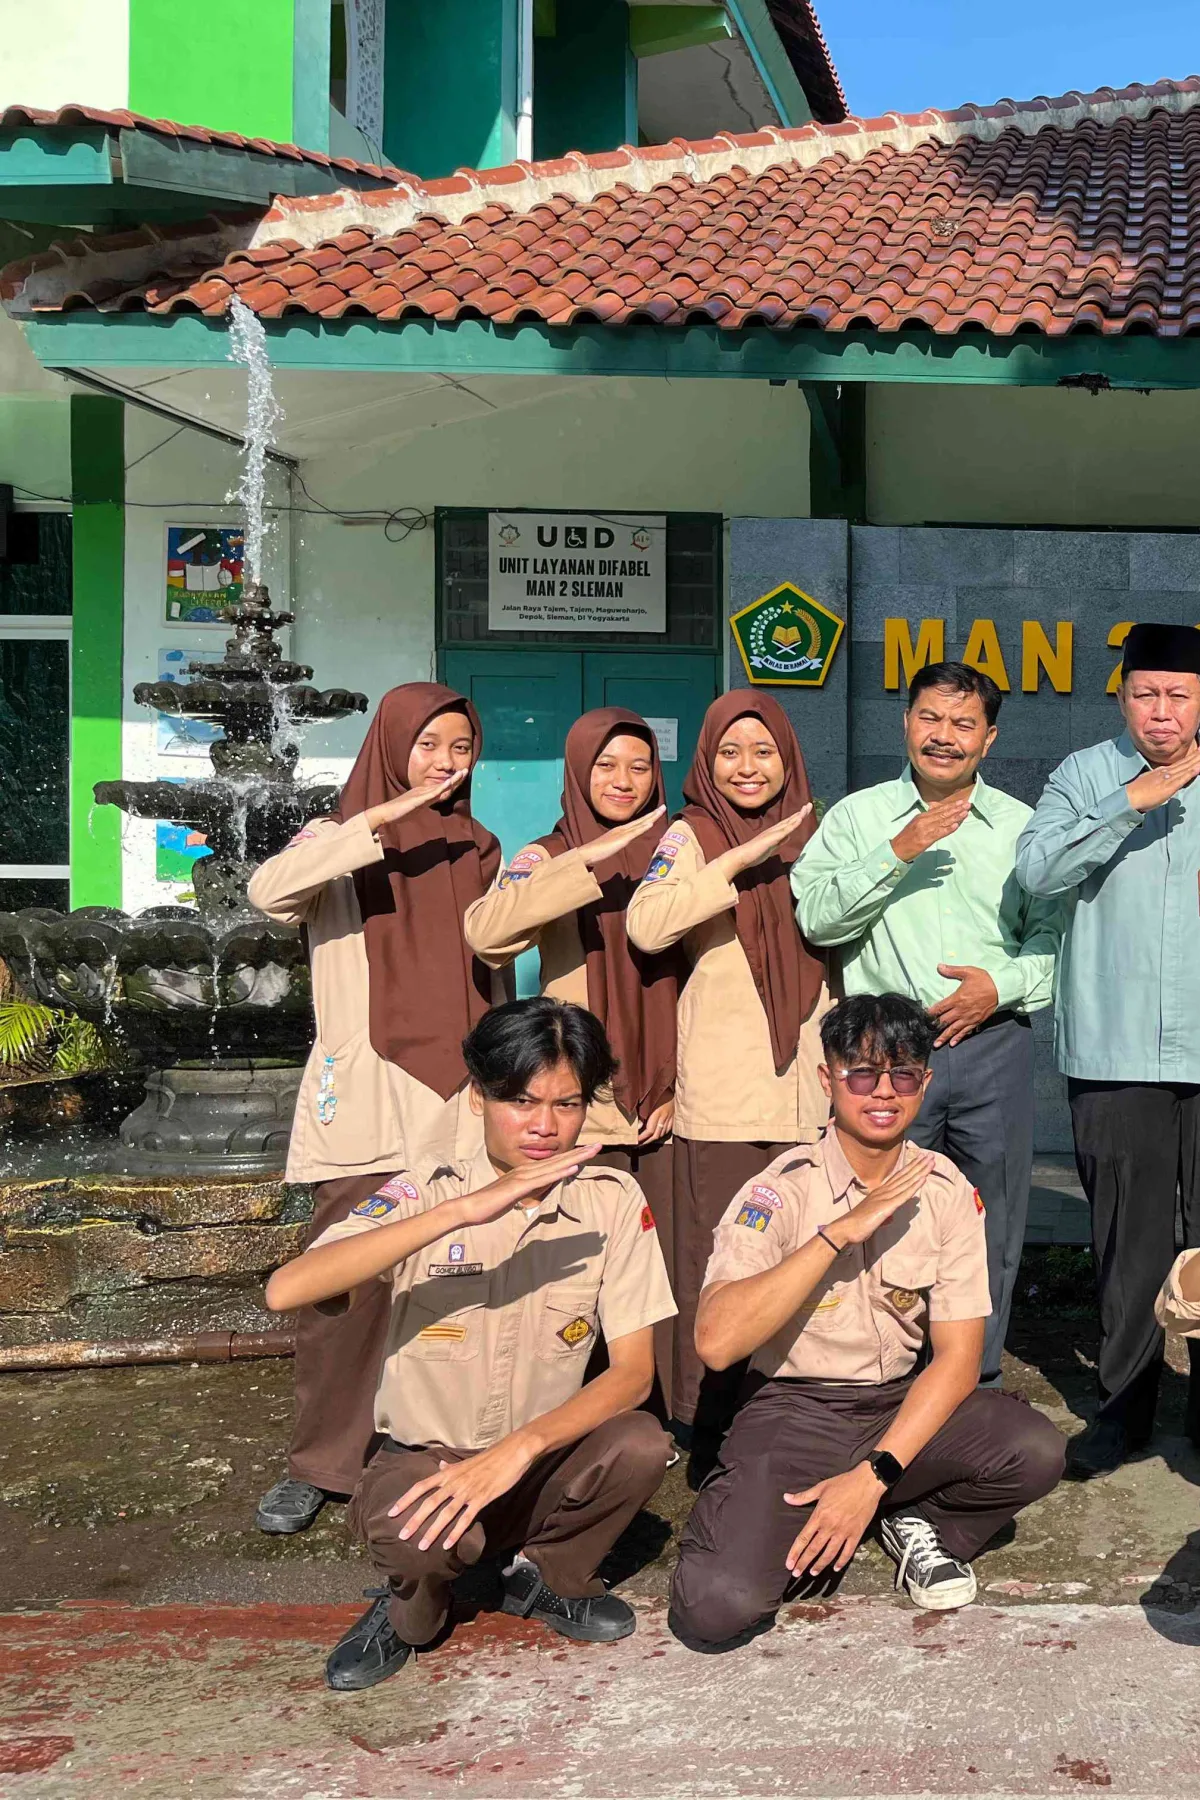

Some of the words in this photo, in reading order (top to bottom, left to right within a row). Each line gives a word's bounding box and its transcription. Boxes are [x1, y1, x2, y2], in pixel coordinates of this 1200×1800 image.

[499, 557, 529, 573] UNIT
[533, 558, 594, 575] LAYANAN
[599, 560, 650, 576] DIFABEL
[526, 579, 556, 597] MAN
[559, 580, 568, 597] 2
[571, 580, 624, 598] SLEMAN
[501, 604, 522, 612] Jalan
[523, 605, 542, 613] Raya
[543, 605, 568, 613] Tajem,
[569, 606, 594, 614] Tajem,
[596, 606, 648, 615] Maguwoharjo,
[518, 613, 545, 621] Depok,
[546, 614, 576, 622] Sleman,
[587, 614, 630, 623] Yogyakarta
[884, 618, 1073, 693] MAN
